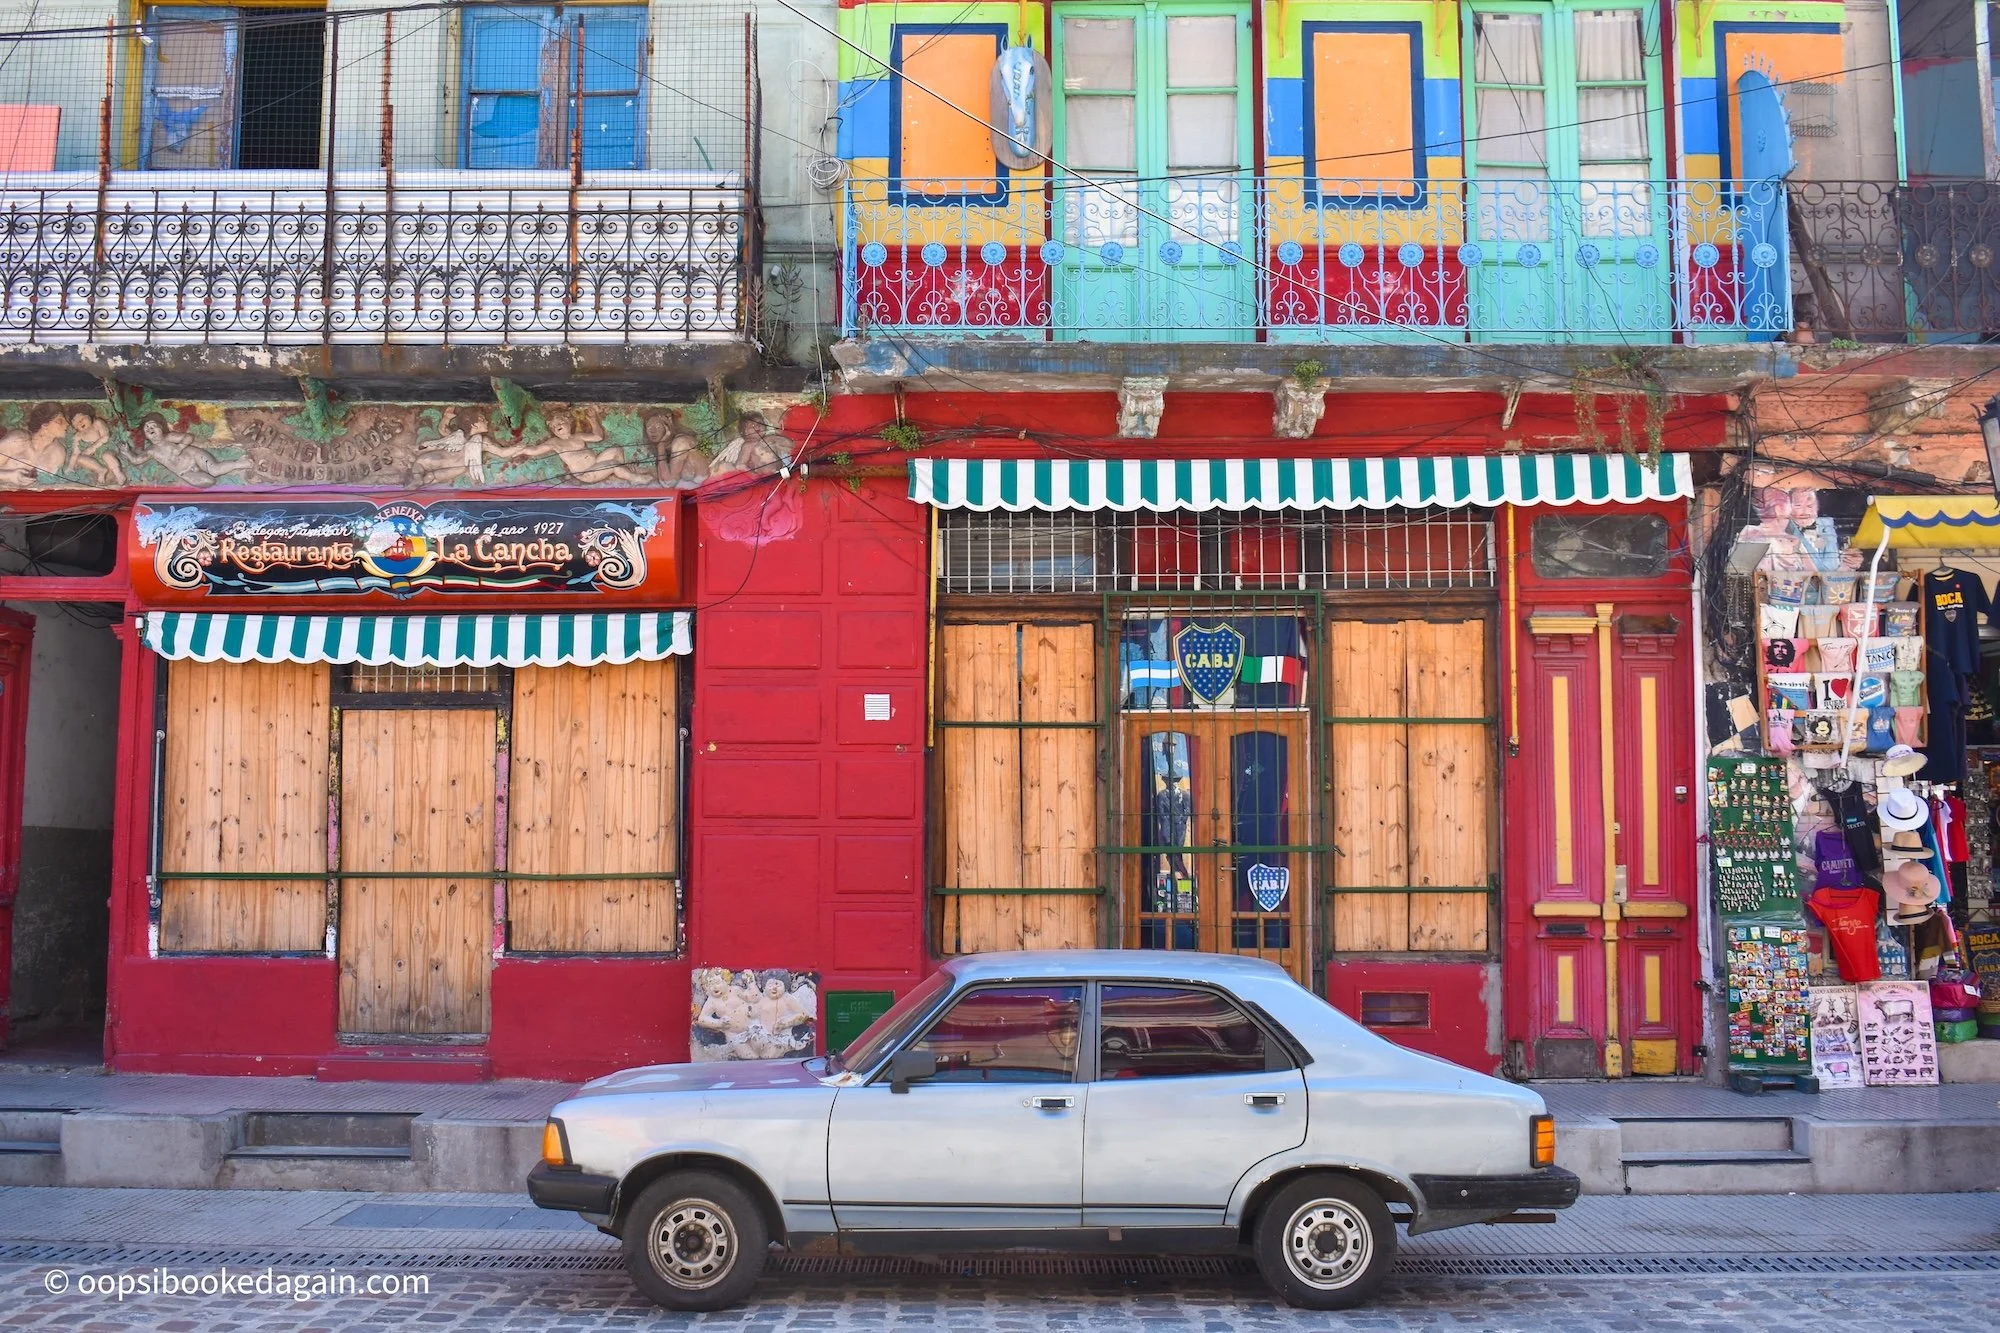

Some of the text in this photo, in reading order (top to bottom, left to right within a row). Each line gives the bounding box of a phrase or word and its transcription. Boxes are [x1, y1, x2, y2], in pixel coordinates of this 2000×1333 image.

[374, 506, 425, 524] XENEIXE
[533, 522, 565, 535] 1927
[220, 538, 354, 572] Restaurante
[435, 534, 573, 571] La Cancha
[1935, 592, 1963, 606] BOCA
[1185, 654, 1234, 669] CABJ
[1823, 680, 1832, 700] I
[1969, 933, 1999, 945] BOCA
